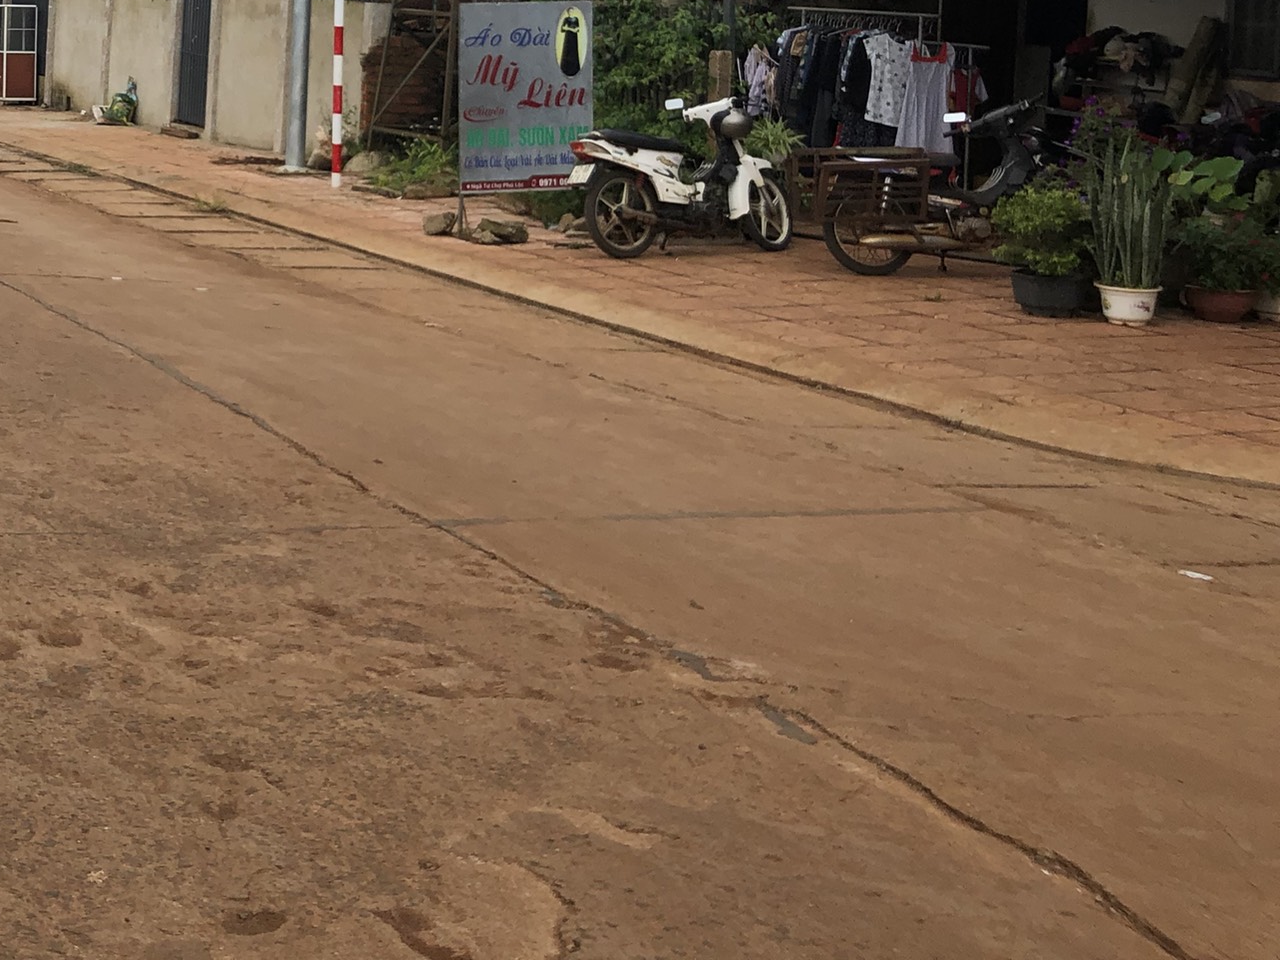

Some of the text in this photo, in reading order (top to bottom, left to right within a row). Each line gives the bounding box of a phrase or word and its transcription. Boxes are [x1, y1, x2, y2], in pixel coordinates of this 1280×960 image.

[464, 23, 502, 47] Áo
[466, 54, 520, 91] Mỹ
[517, 77, 586, 109] Liên
[539, 177, 557, 187] 0971
